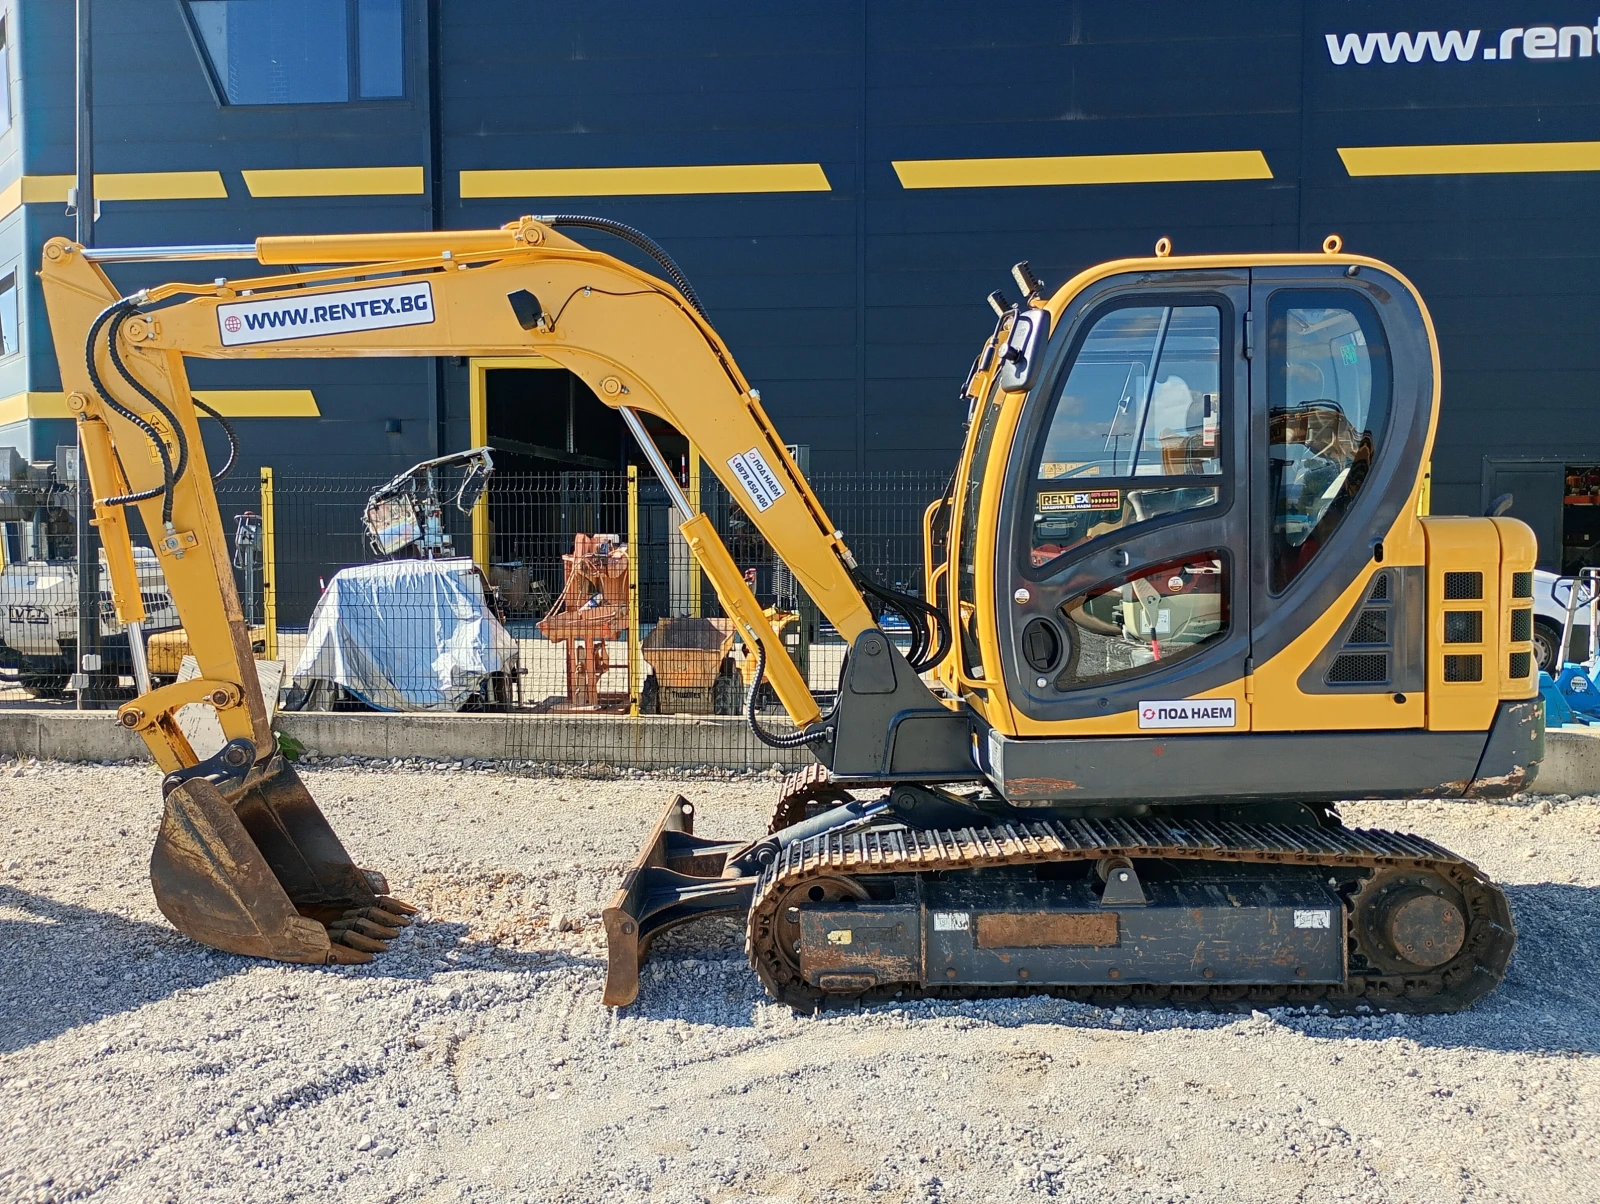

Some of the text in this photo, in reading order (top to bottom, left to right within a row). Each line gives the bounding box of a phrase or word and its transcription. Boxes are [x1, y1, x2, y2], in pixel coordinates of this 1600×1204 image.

[1325, 16, 1600, 65] www.ren
[244, 294, 428, 331] WWW.RENTEX.BG
[735, 463, 768, 507] 0878 450 400
[764, 475, 780, 496] НАЕМ
[1043, 494, 1088, 505] RENTEX
[1158, 707, 1232, 720] ПОД НАЕМ
